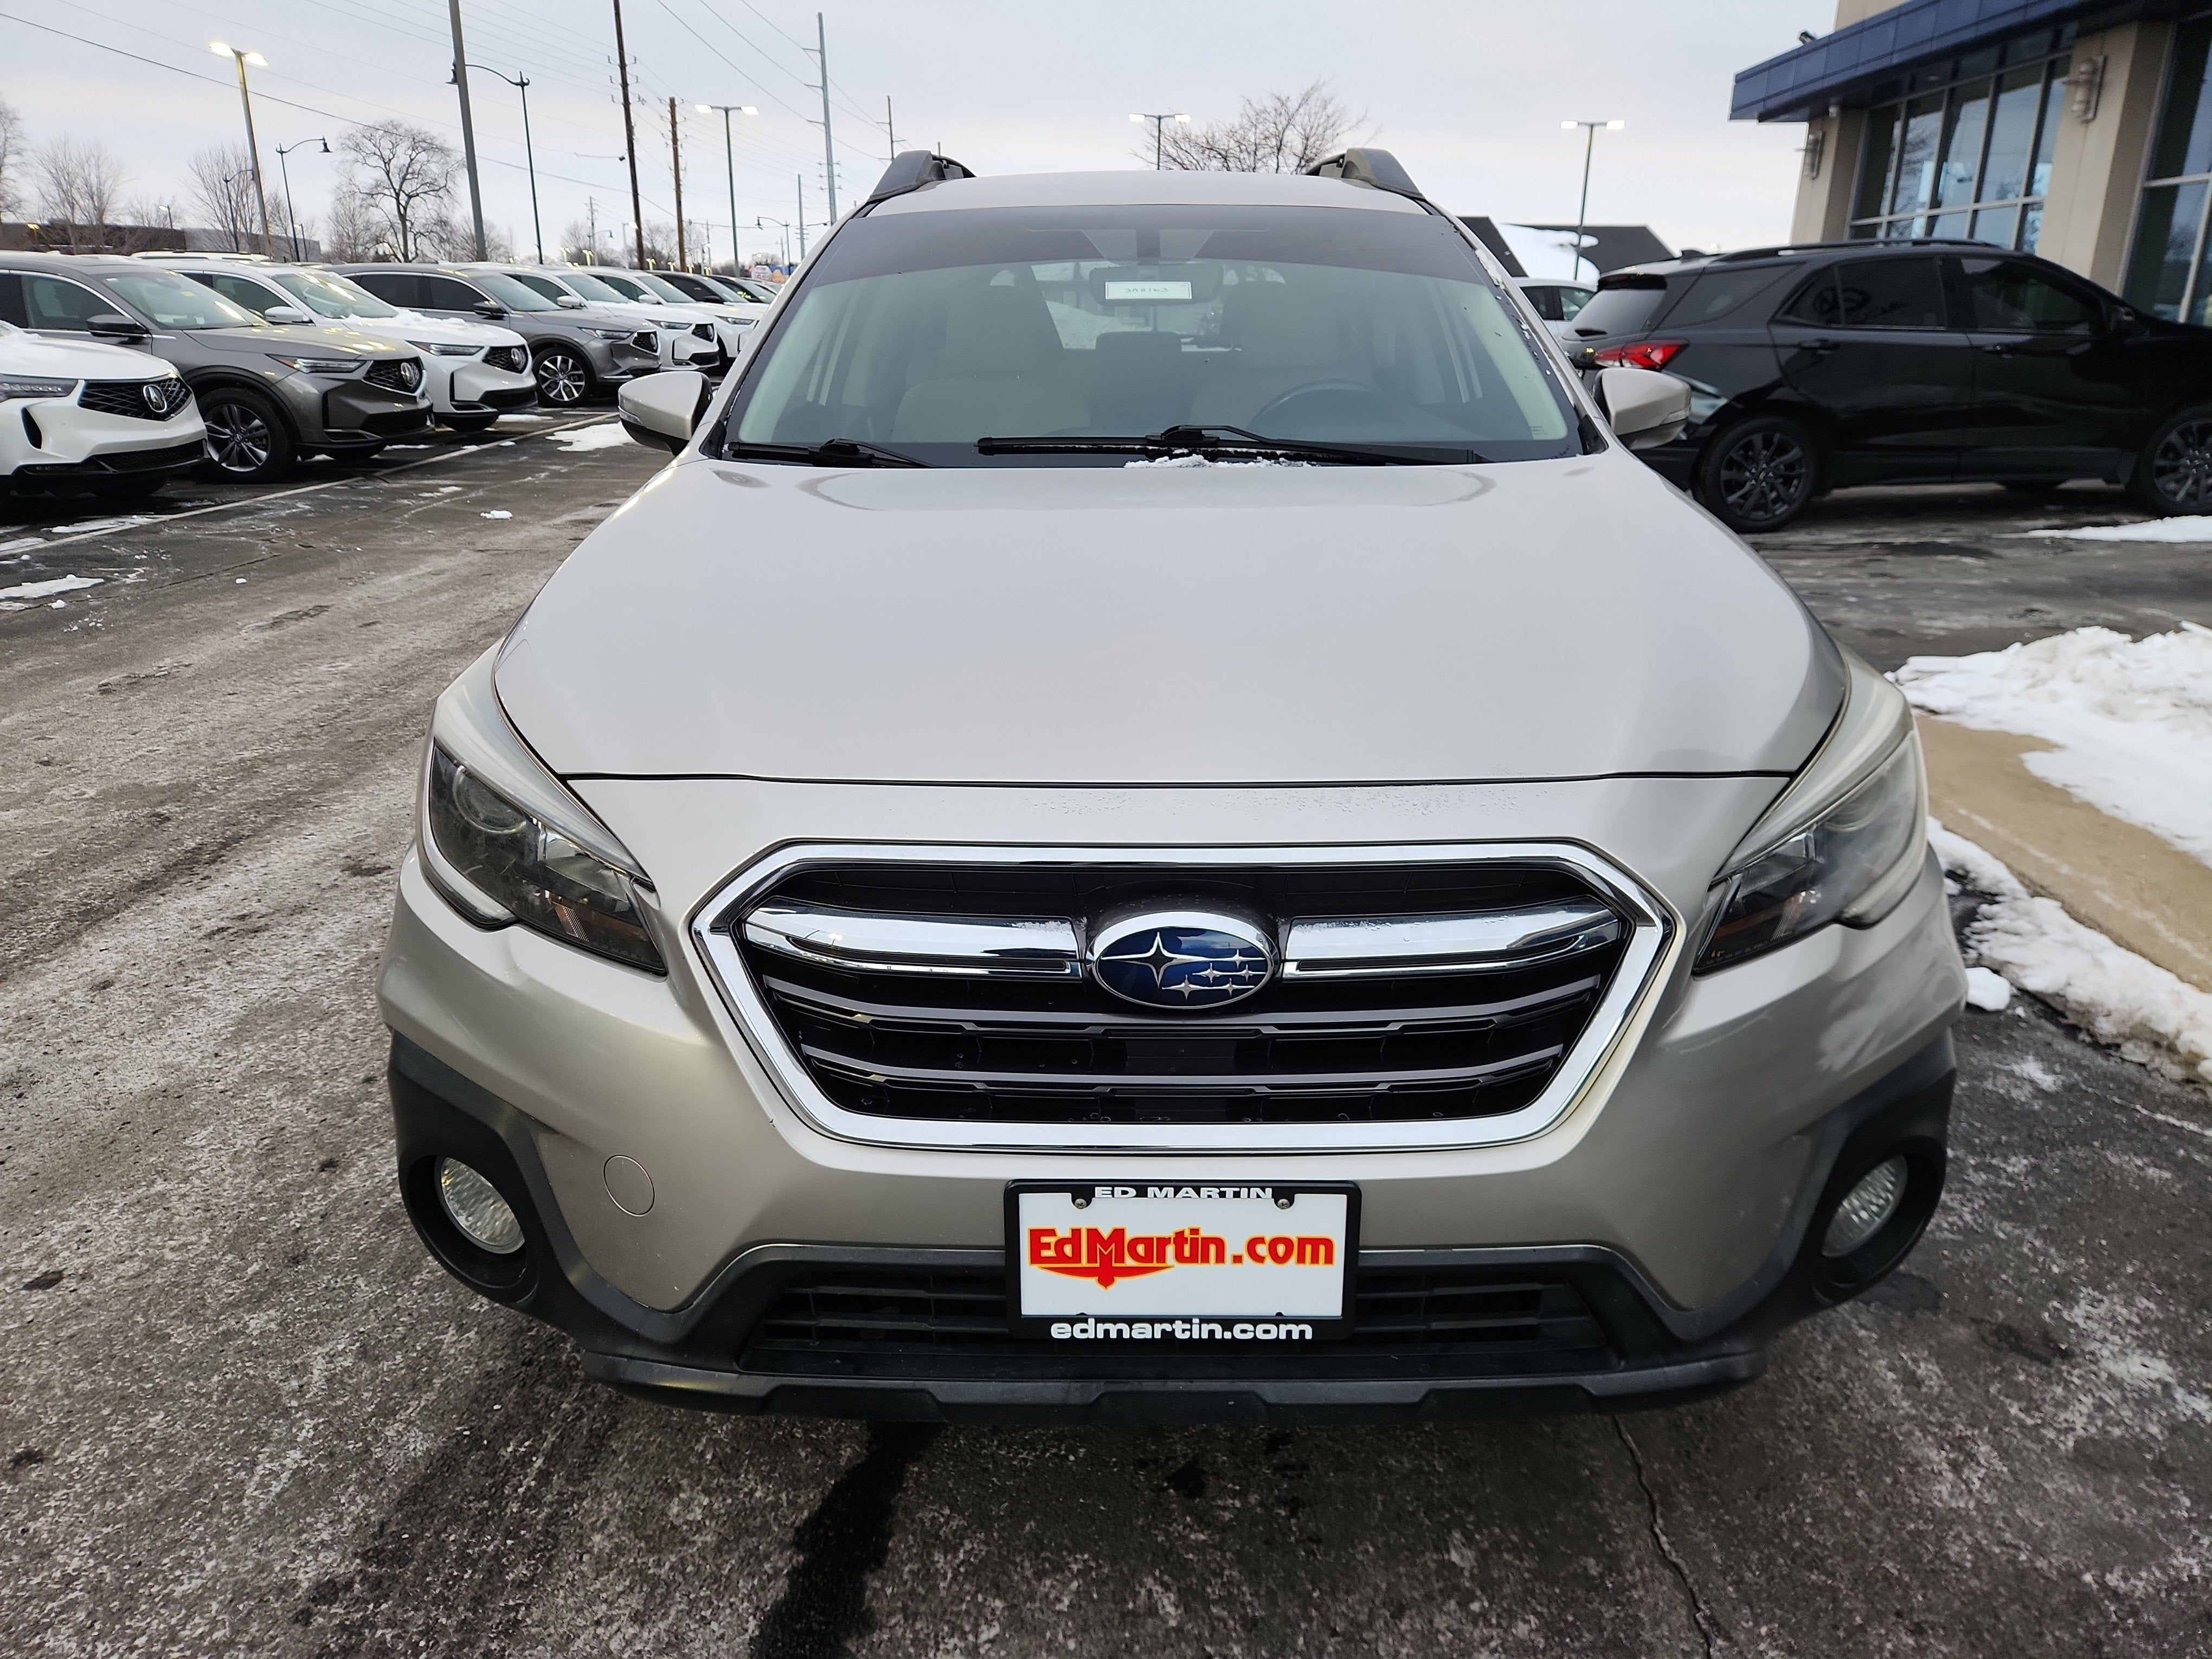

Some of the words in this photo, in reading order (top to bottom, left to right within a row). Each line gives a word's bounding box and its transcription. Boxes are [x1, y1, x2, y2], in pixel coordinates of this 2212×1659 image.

[1095, 1186, 1136, 1198] ED
[1147, 1187, 1272, 1199] MARTIN
[1028, 1227, 1335, 1268] EdMartin.com
[1051, 1318, 1313, 1340] edmartin.com
